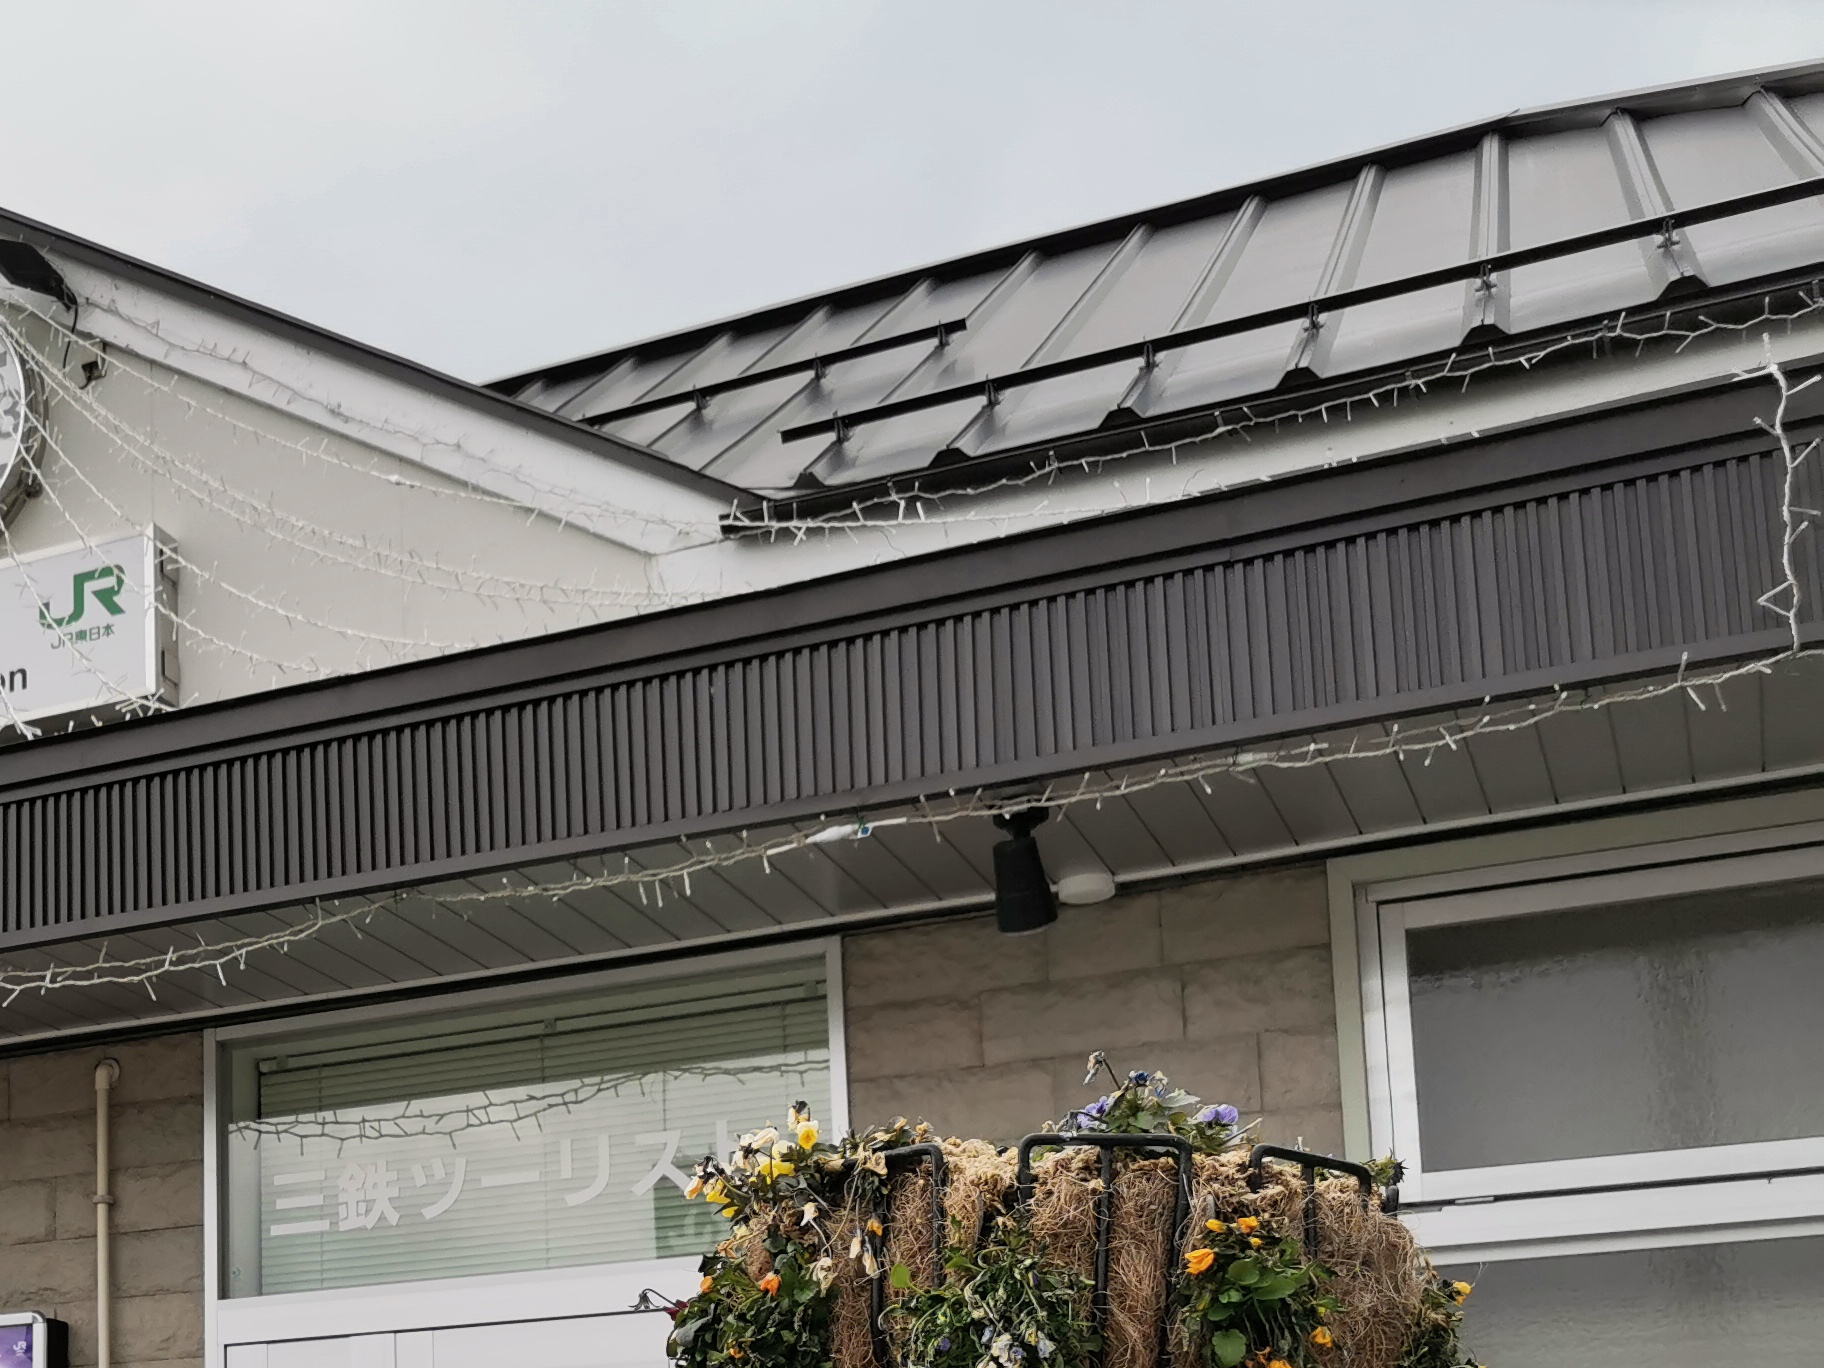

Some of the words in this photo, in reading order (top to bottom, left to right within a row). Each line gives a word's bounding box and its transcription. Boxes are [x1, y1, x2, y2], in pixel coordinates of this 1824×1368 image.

[38, 564, 127, 629] JR
[50, 623, 116, 649] JR東日本
